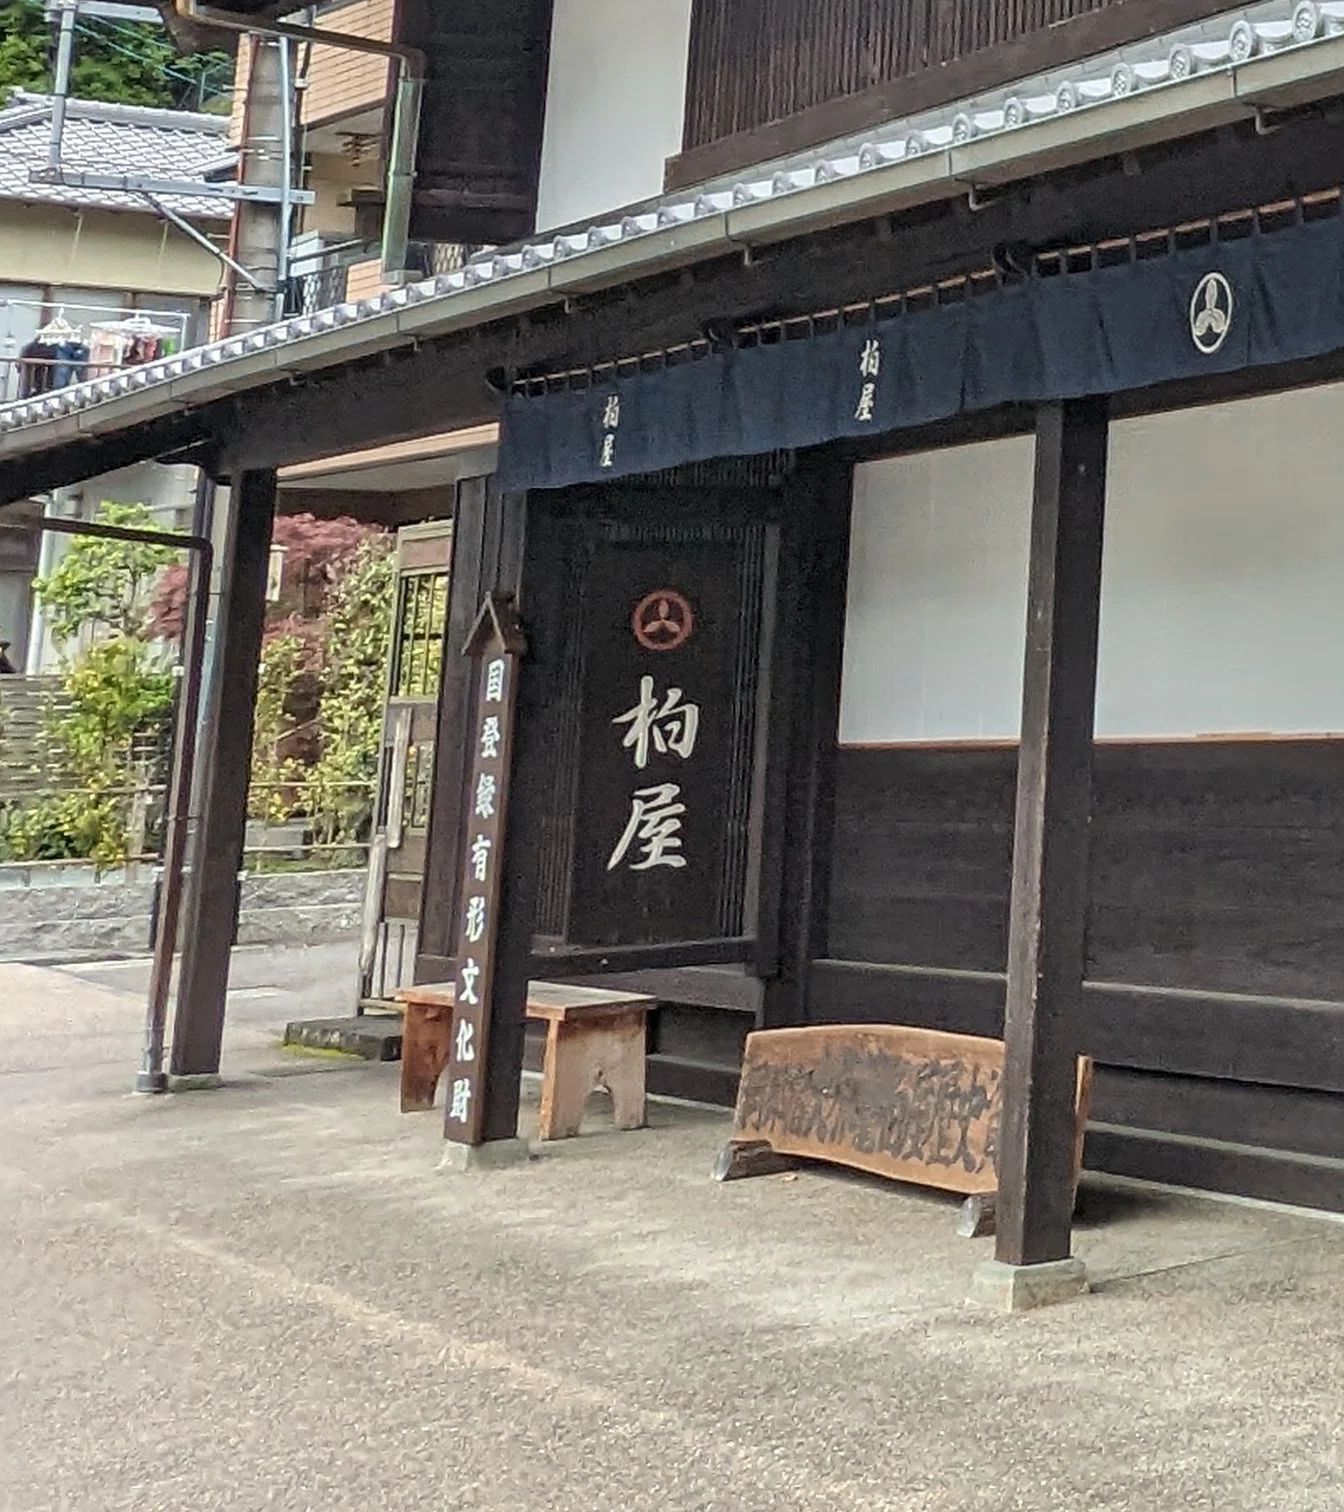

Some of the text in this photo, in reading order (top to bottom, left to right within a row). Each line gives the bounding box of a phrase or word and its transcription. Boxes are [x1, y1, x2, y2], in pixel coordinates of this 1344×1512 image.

[855, 339, 881, 422] 柏屋
[602, 394, 621, 467] 柏屋
[607, 675, 699, 871] 柏屋
